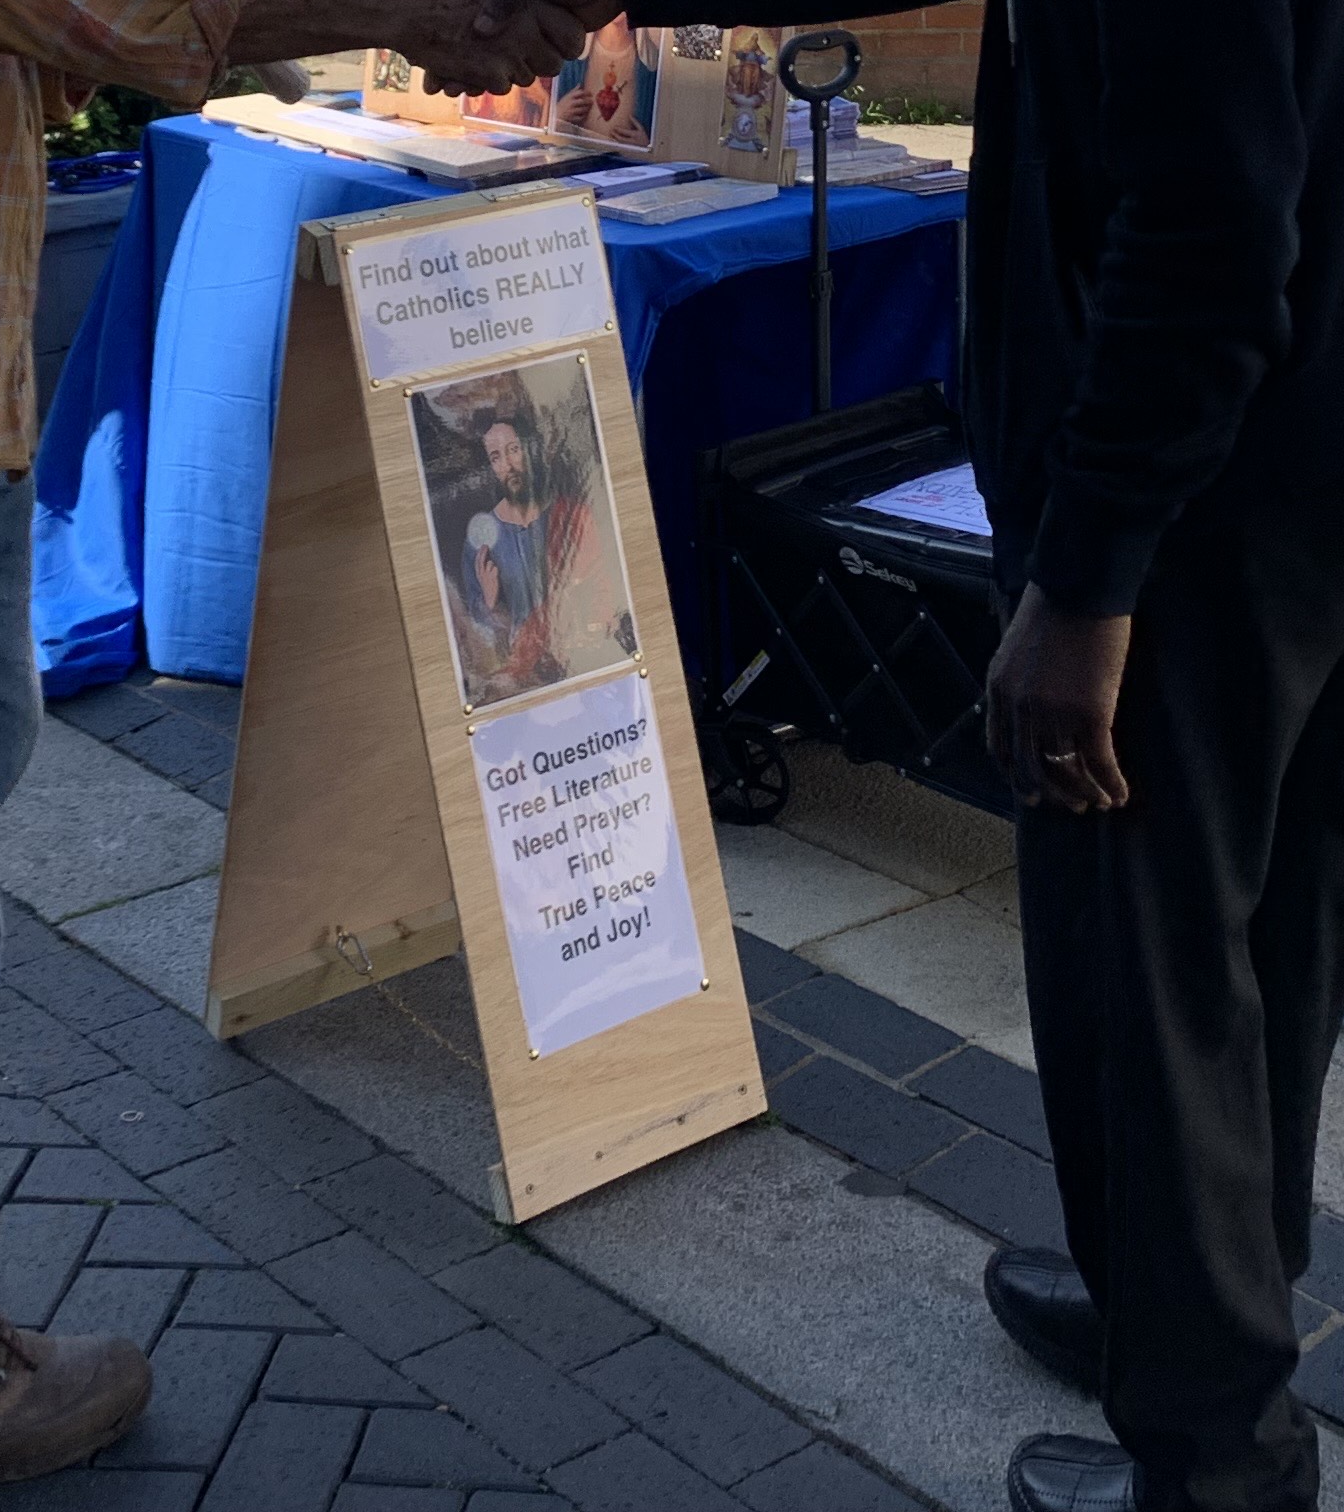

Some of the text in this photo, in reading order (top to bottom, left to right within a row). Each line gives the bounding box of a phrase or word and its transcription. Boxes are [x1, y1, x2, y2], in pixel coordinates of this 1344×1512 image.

[358, 226, 590, 289] Find out about what
[376, 261, 586, 326] Catholics REALLY
[449, 315, 534, 350] believe
[486, 718, 648, 792] Got Questions?
[497, 756, 652, 828] Free Literature
[512, 792, 652, 862] Need Prayer?
[567, 841, 615, 879] Find
[538, 870, 656, 930] True Peace
[560, 905, 652, 962] and Joy!
